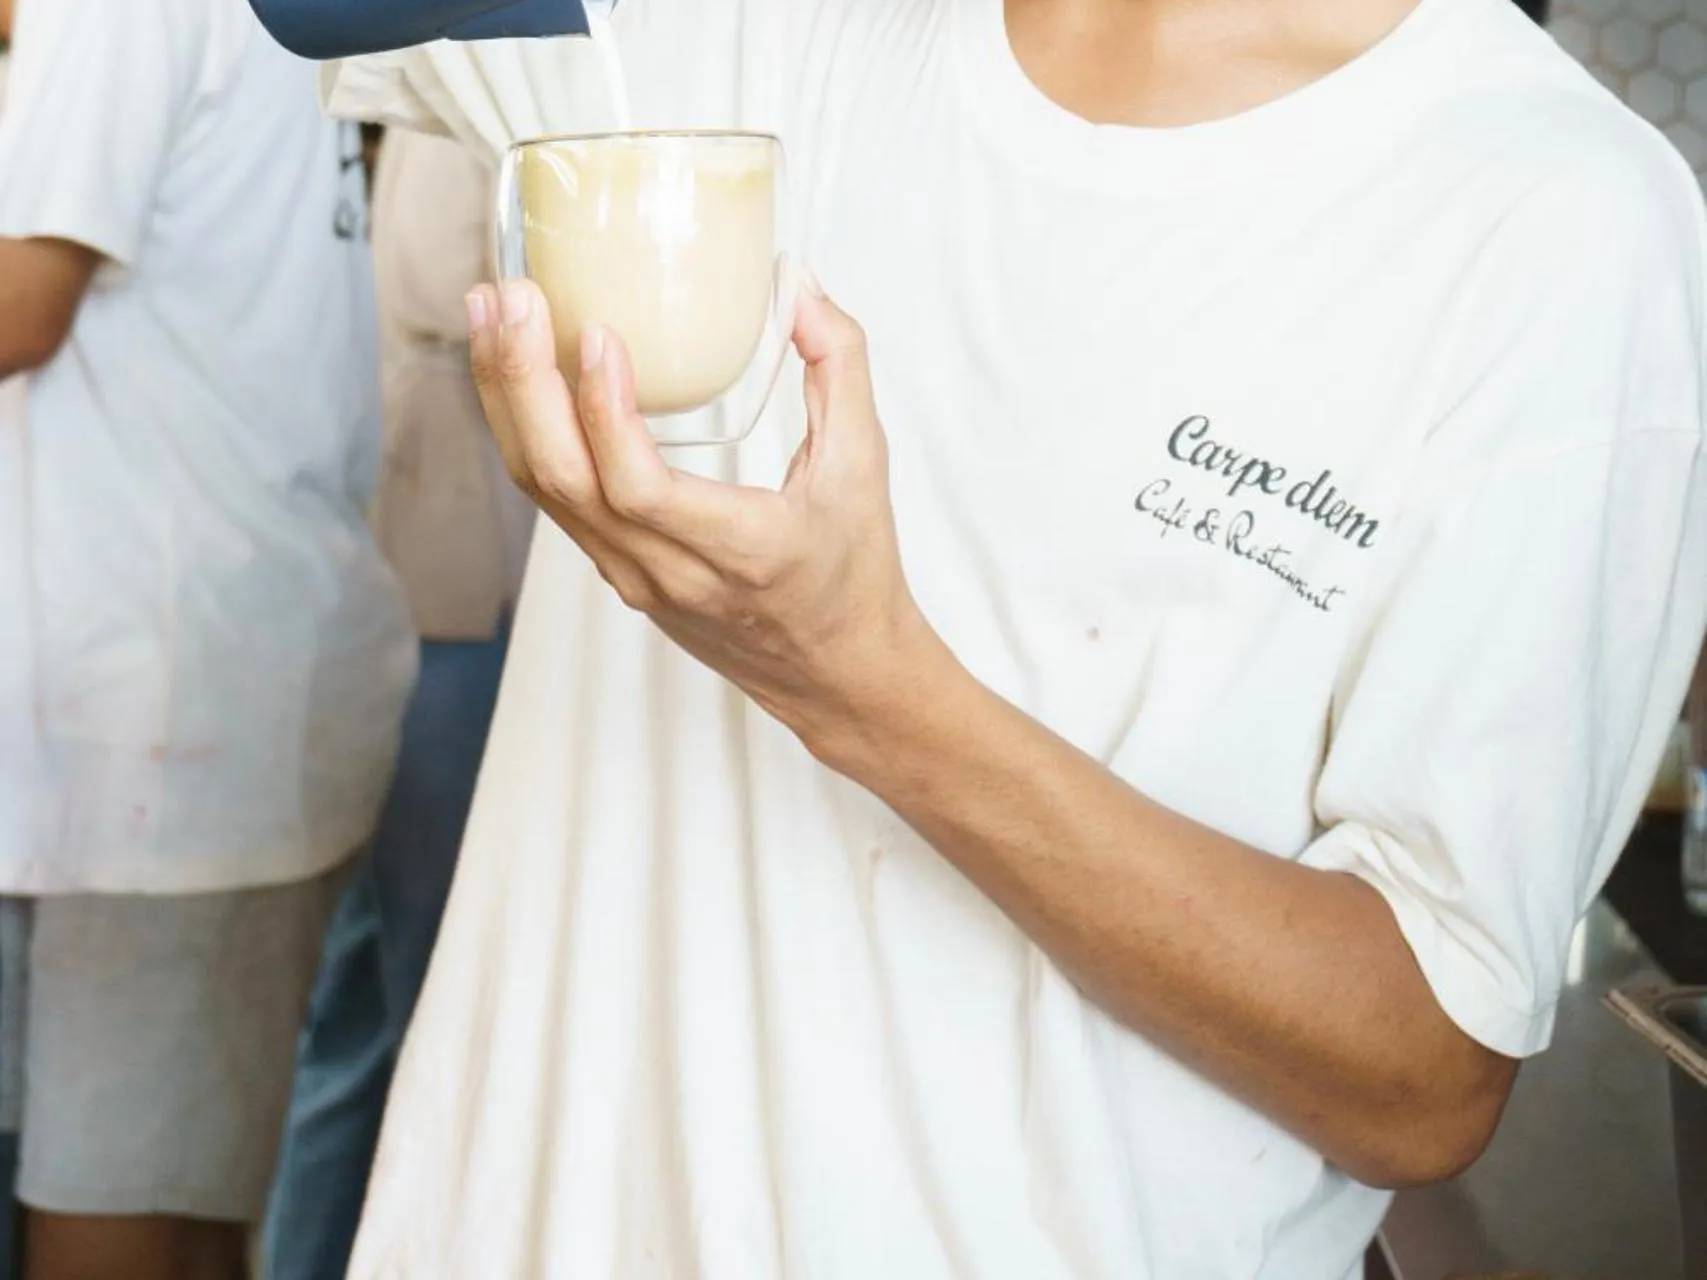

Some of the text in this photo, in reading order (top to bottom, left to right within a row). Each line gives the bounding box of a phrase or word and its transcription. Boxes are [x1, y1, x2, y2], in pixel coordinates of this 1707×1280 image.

[1167, 414, 1379, 548] Carpe diem
[1194, 508, 1220, 544] &
